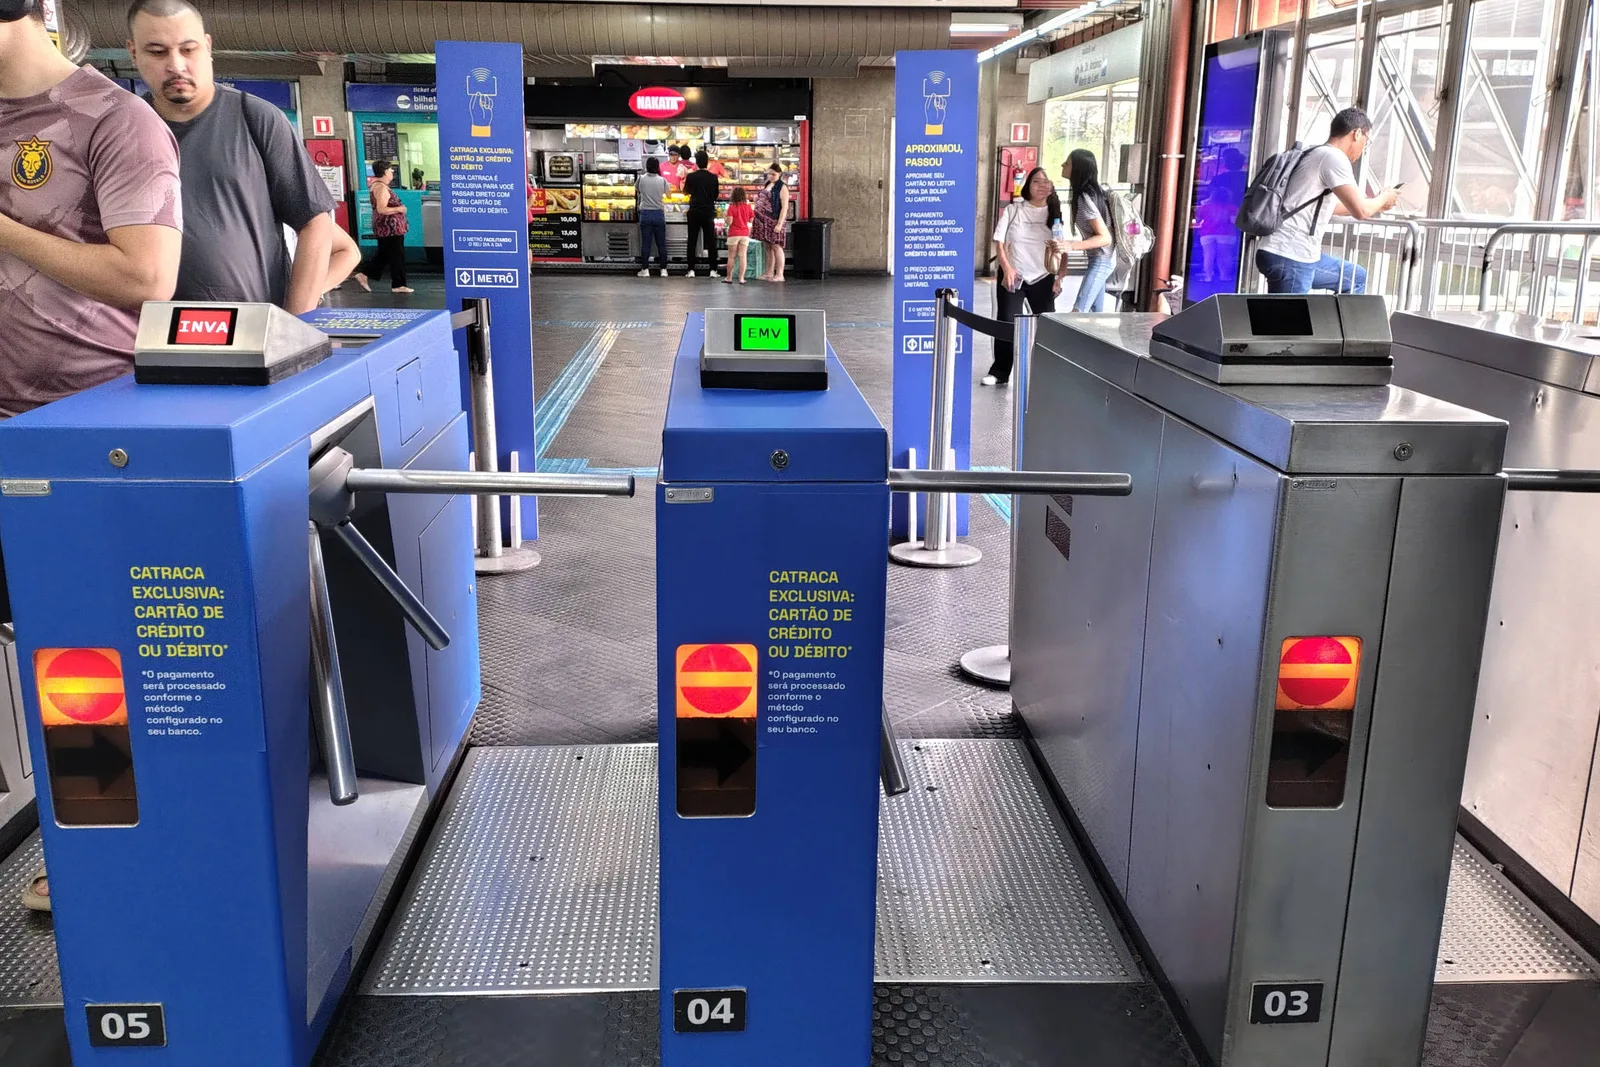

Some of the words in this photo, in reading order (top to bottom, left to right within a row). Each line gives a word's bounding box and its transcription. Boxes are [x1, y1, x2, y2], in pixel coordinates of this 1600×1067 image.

[637, 96, 684, 110] NAKATA
[906, 144, 963, 154] APROXIMOU,
[906, 158, 942, 166] PASSOU
[478, 273, 513, 283] METRÔ
[179, 321, 228, 333] INVA
[748, 328, 781, 339] EMV
[130, 567, 204, 579] CATRACA
[770, 571, 838, 583] CATRACA
[132, 586, 224, 599] EXCLUSIVA:
[770, 590, 854, 602] EXCLUSIVA:
[134, 603, 198, 618] CARTÃO
[203, 606, 224, 618] DE
[769, 606, 828, 621] CARTÃO
[833, 609, 852, 621] DE
[137, 622, 204, 638] CRÉDITO
[769, 625, 832, 639] CRÉDITO
[139, 644, 161, 656] OU
[769, 646, 789, 658] OU
[157, 672, 214, 680] pagamento
[783, 672, 836, 680] pagamento
[167, 682, 225, 691] processado
[791, 682, 845, 691] processado
[147, 716, 207, 725] configurado
[768, 715, 824, 724] configurado
[1264, 990, 1309, 1016] 03
[688, 998, 734, 1024] 04
[101, 1013, 150, 1039] 05
